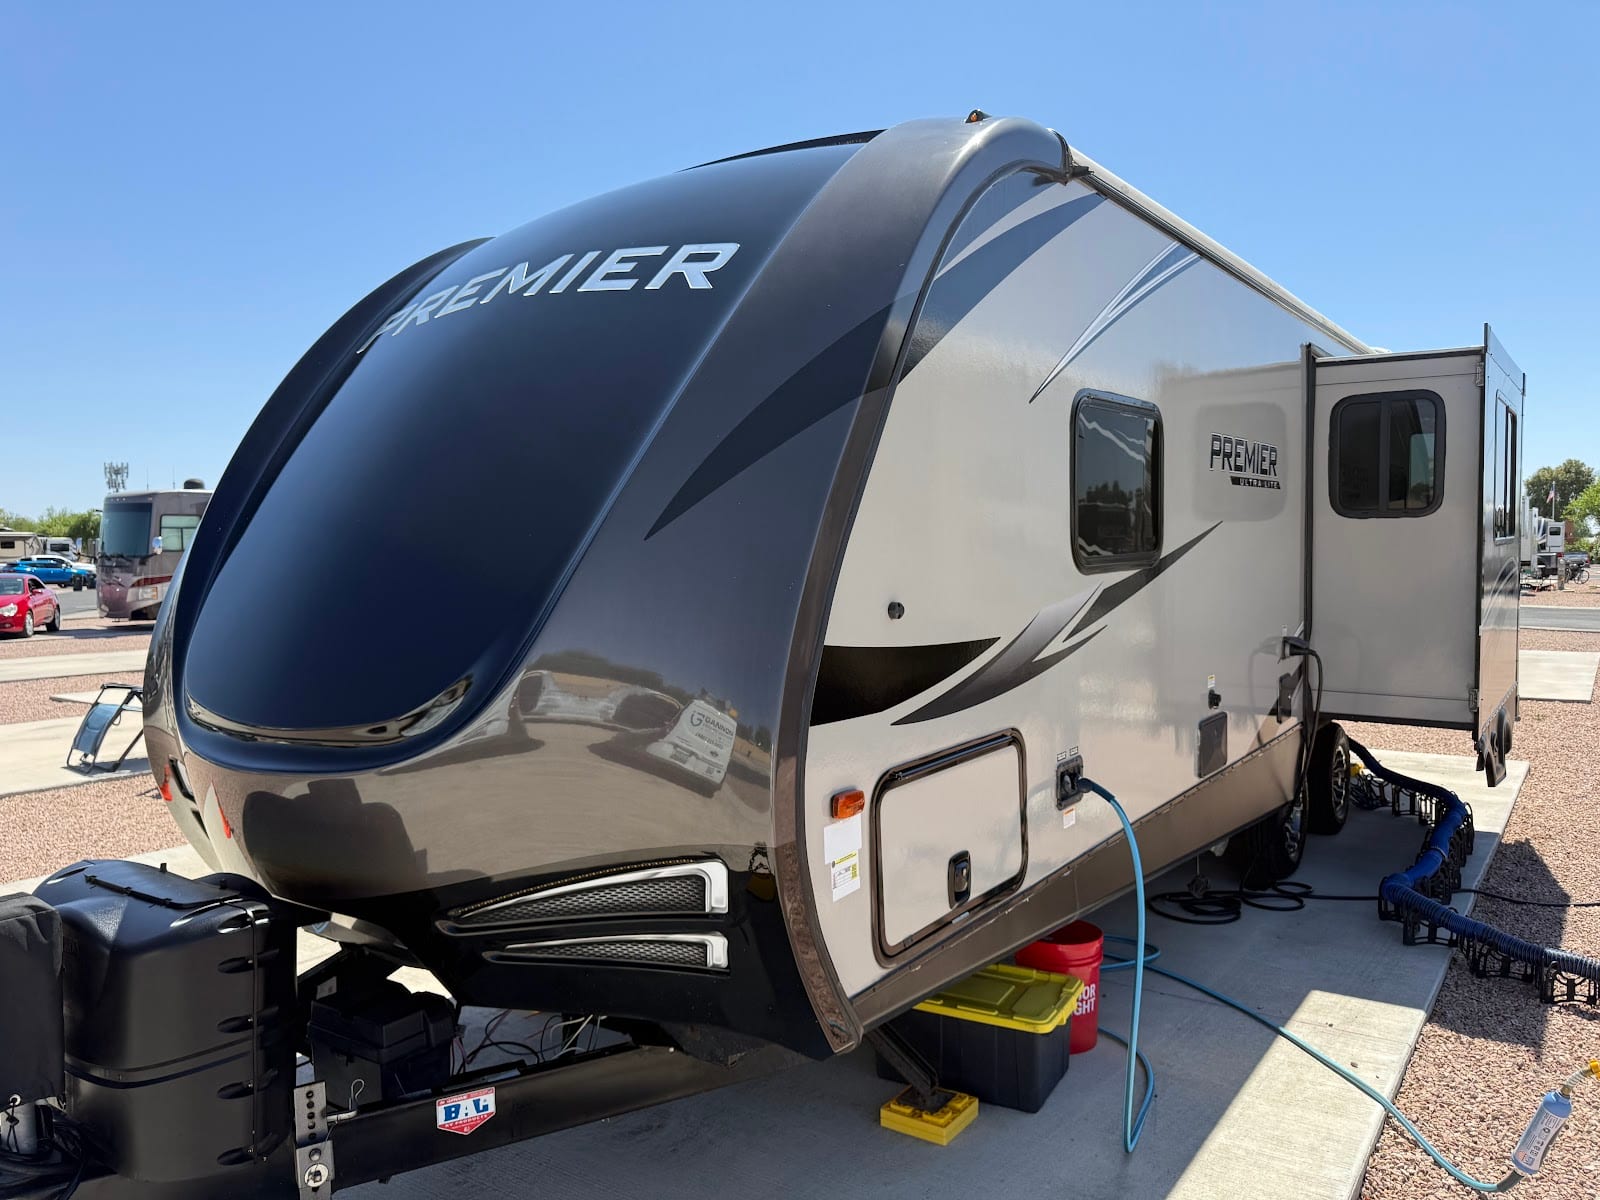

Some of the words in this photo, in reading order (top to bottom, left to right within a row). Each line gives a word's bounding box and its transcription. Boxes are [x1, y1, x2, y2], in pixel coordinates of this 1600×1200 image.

[356, 242, 741, 354] PREMIER
[1209, 432, 1278, 479] PREMIER
[1239, 478, 1262, 488] ULTRA
[1079, 983, 1096, 1000] OR
